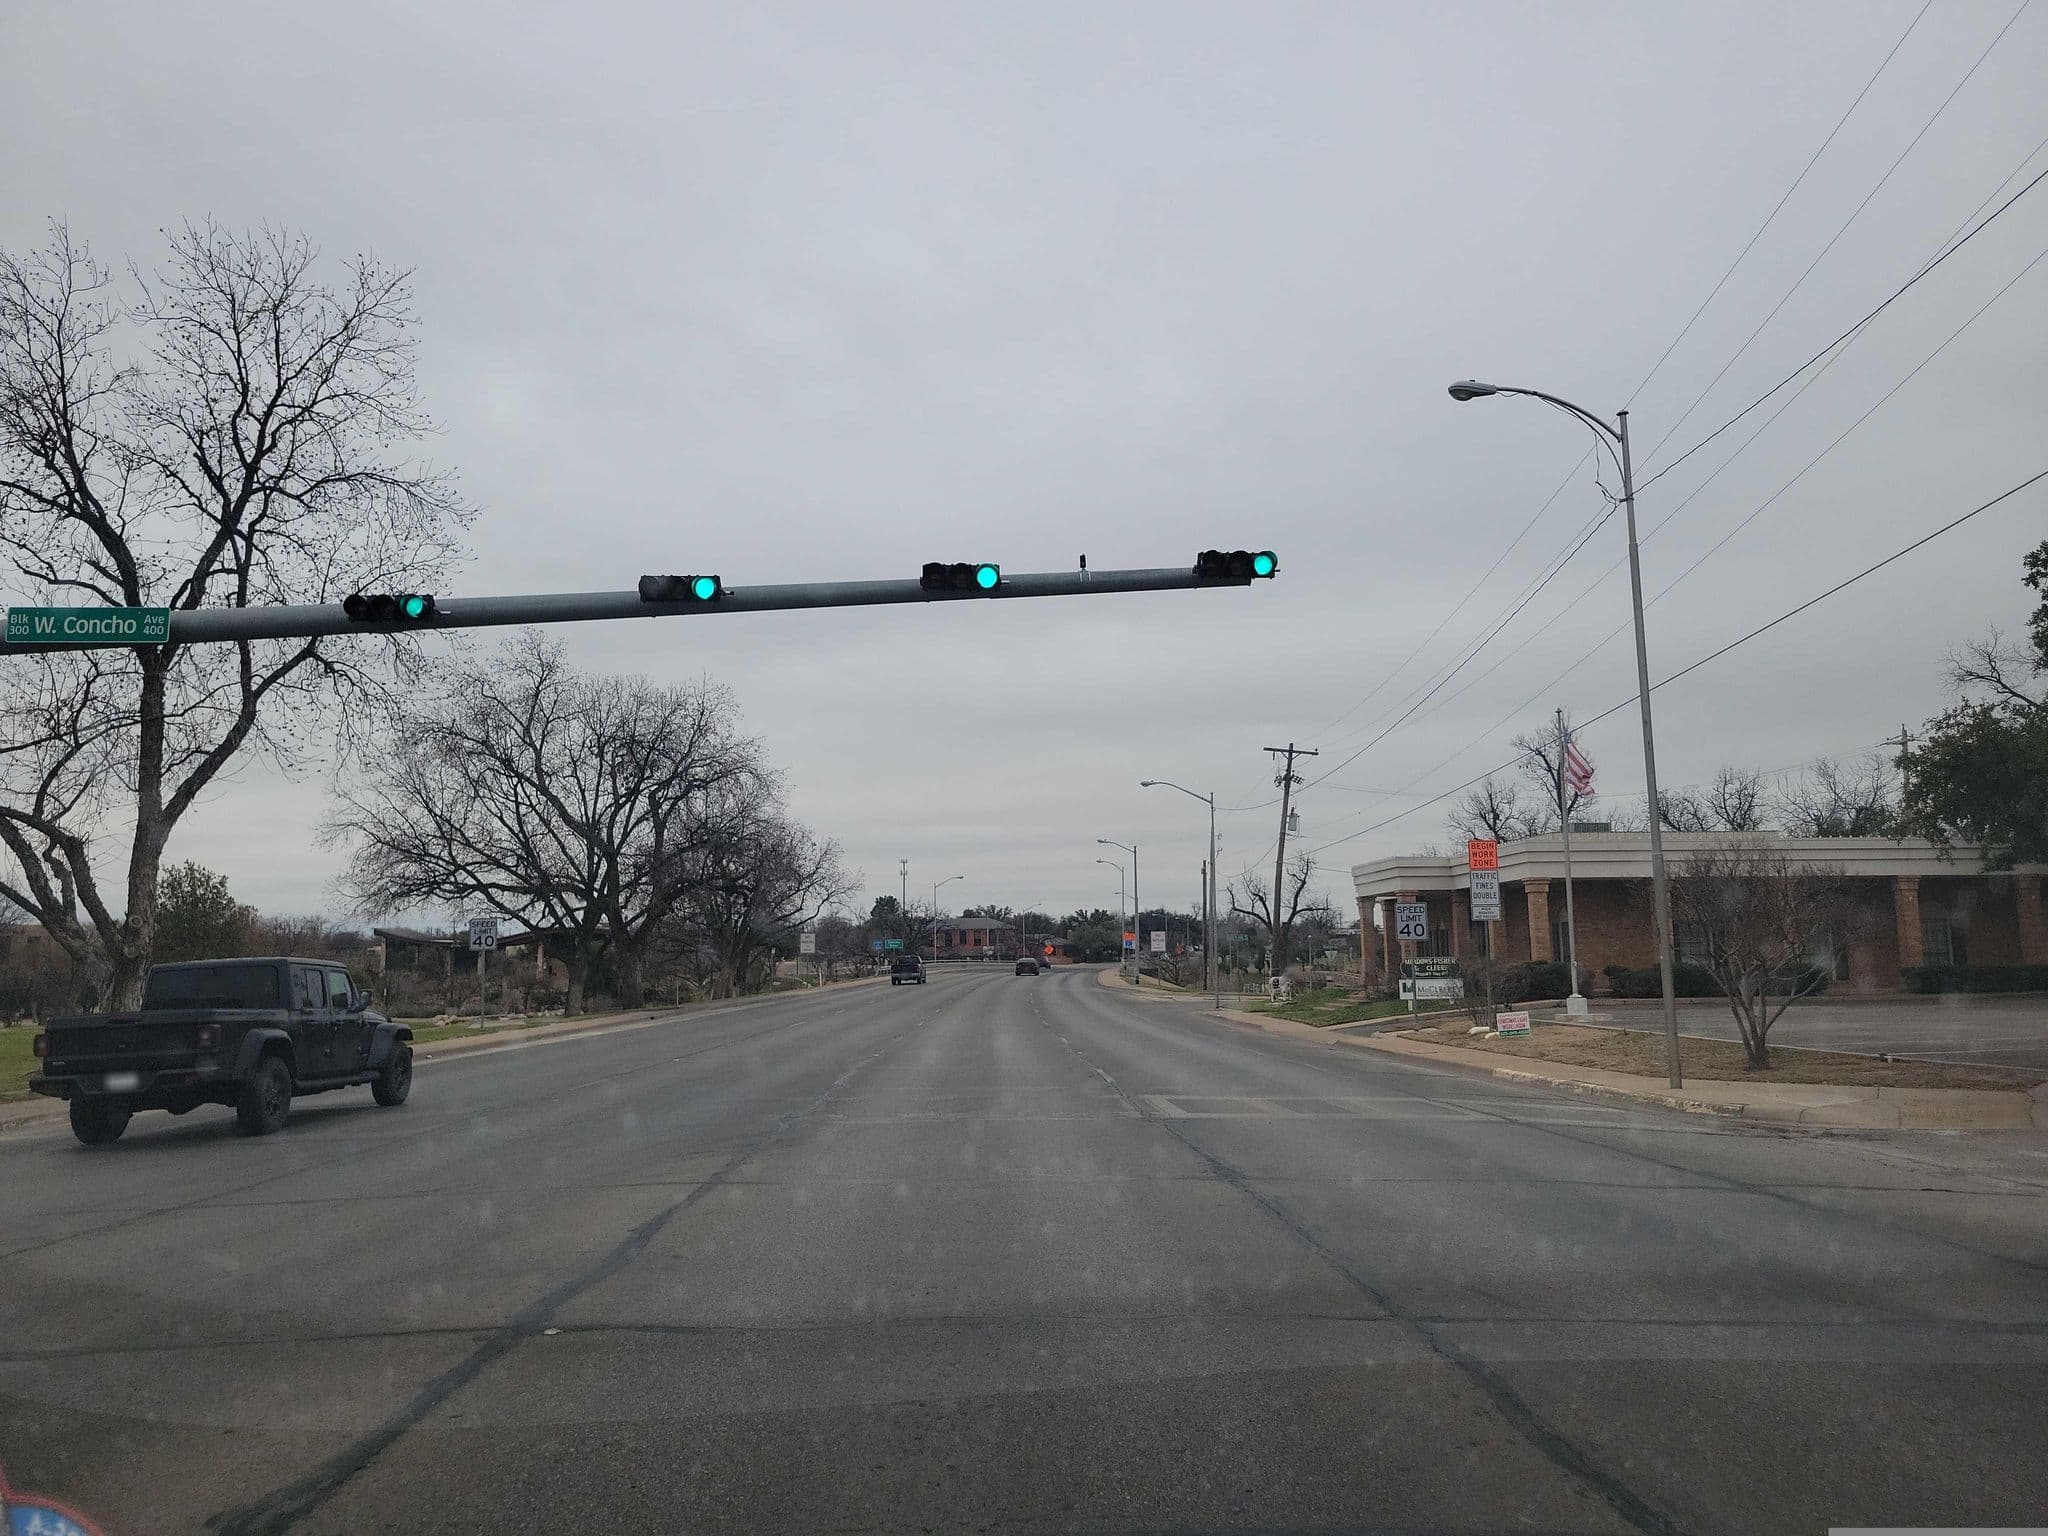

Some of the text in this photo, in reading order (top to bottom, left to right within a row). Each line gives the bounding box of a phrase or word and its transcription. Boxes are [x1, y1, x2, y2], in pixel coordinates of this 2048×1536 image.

[10, 614, 29, 624] Blk
[143, 614, 165, 624] Ave
[34, 615, 137, 634] W. Concho
[9, 625, 30, 635] 300
[143, 625, 165, 635] 400
[1470, 842, 1494, 850] BEGIN
[1472, 872, 1497, 880] TRAFFIC
[1475, 882, 1494, 890] FINES
[1473, 892, 1498, 900] DOUBLE
[1397, 906, 1425, 914] SPEED
[1400, 914, 1423, 922] LIMIT
[471, 920, 497, 928] SPEED
[1399, 923, 1425, 937] 40
[472, 935, 495, 947] 40
